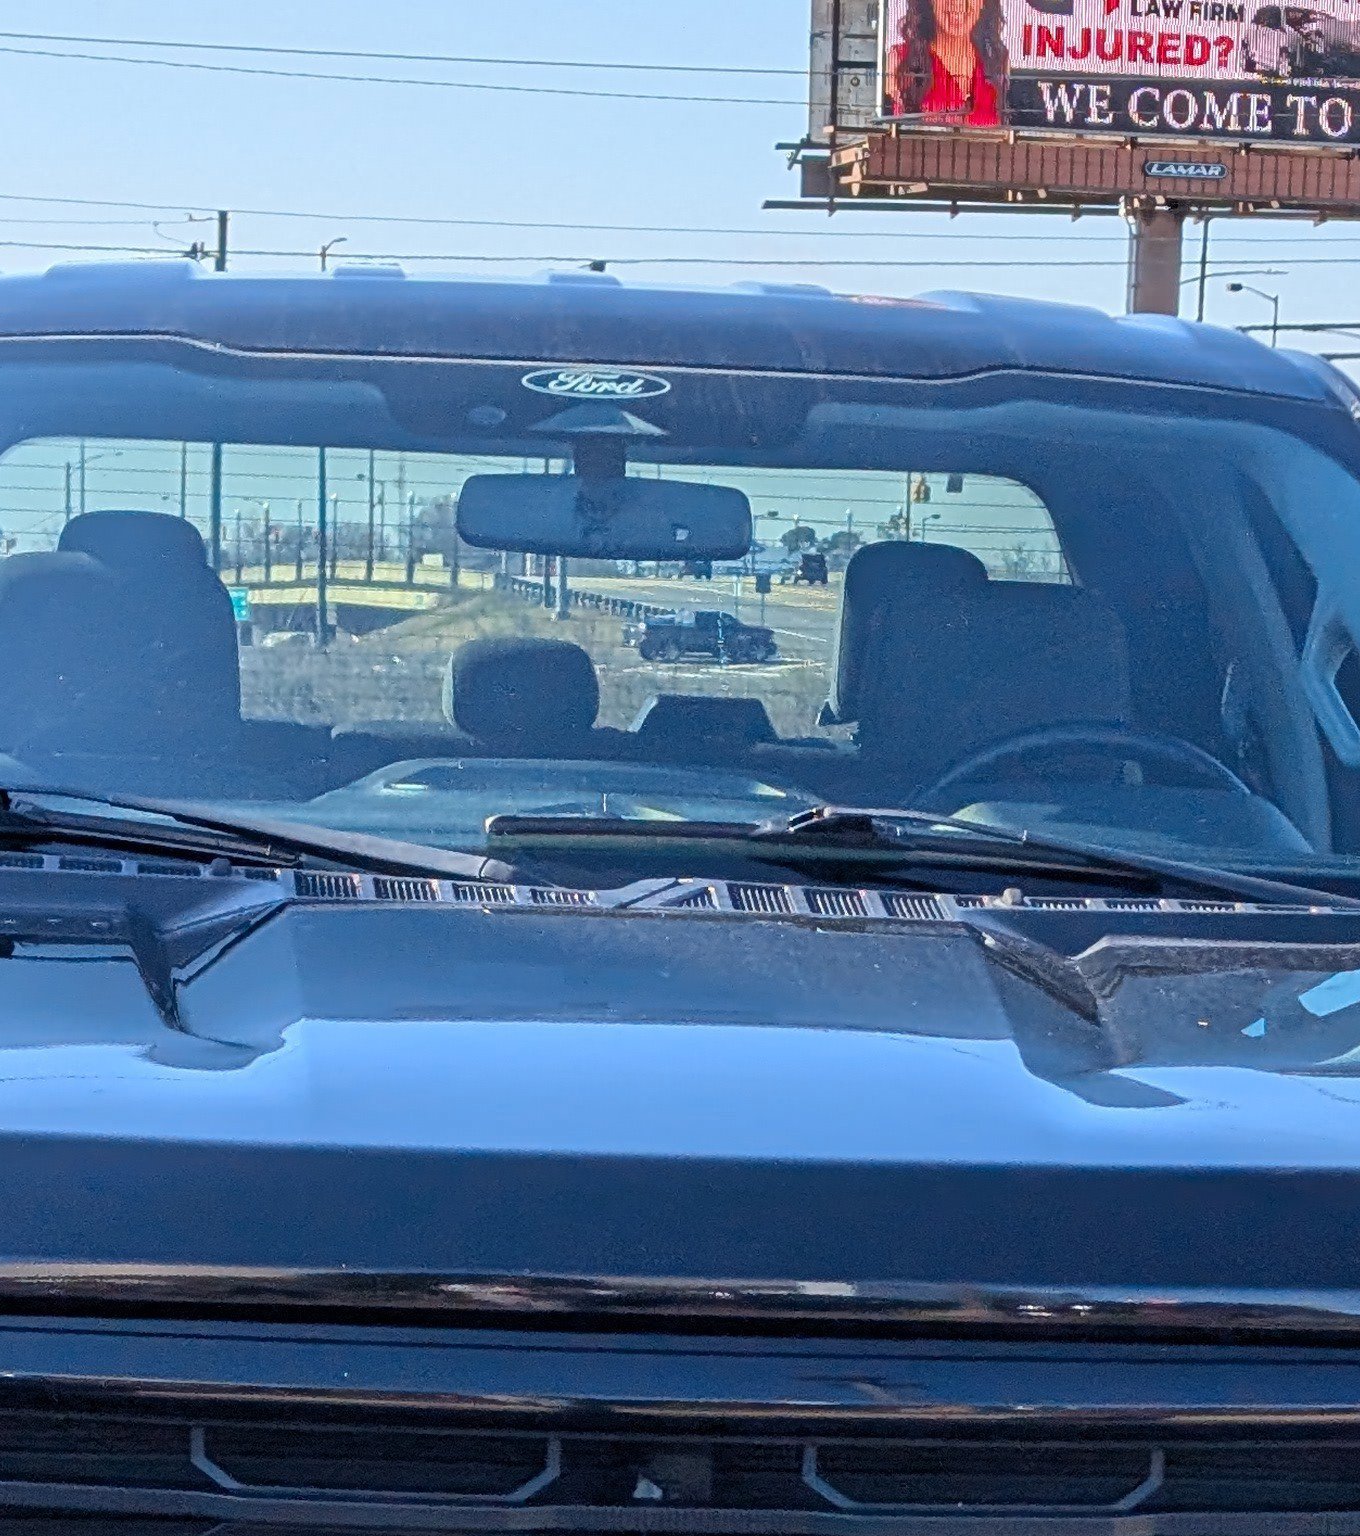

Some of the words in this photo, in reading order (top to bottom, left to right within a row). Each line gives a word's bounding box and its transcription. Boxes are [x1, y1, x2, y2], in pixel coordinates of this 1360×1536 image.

[1023, 24, 1235, 68] INJURED?
[1038, 80, 1113, 123] WE
[1128, 86, 1272, 133] COME
[1286, 94, 1353, 138] TO
[1150, 163, 1222, 176] LAMAR
[548, 371, 645, 395] Ford
